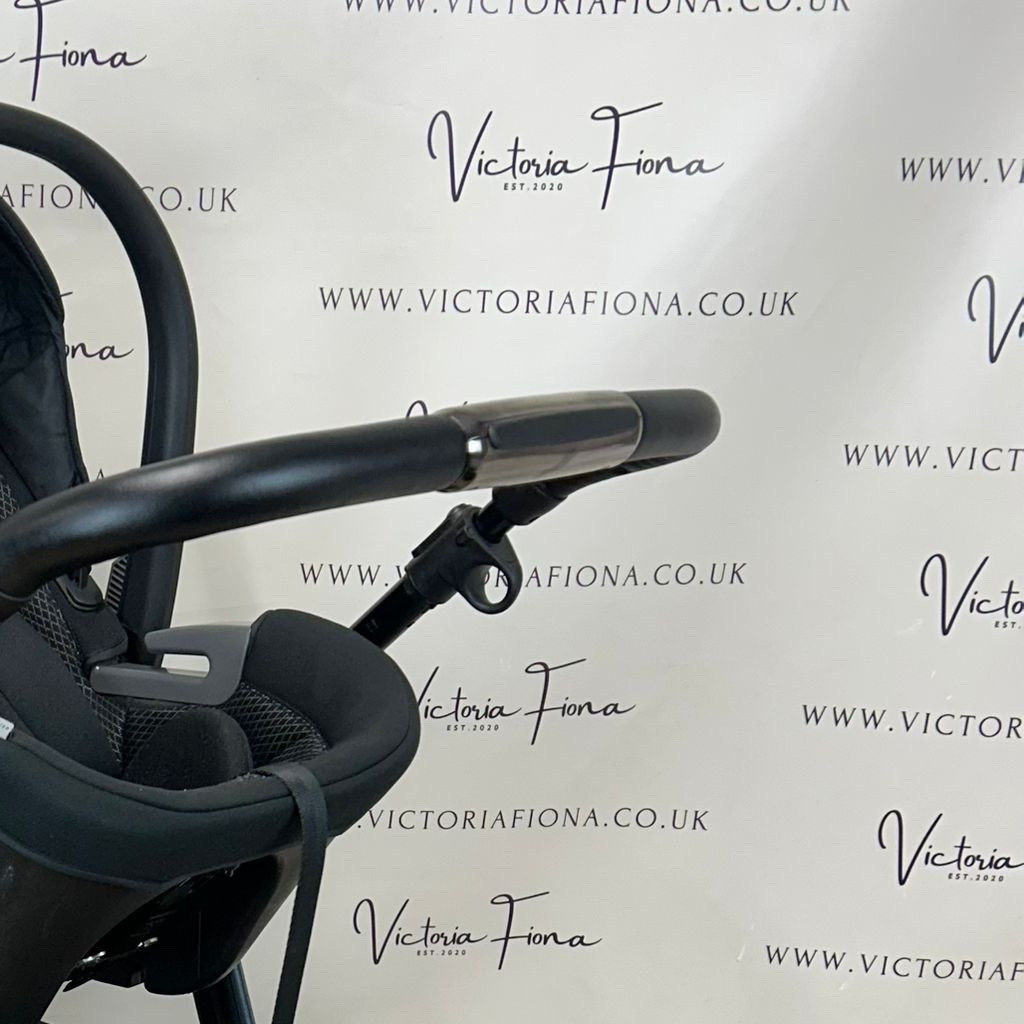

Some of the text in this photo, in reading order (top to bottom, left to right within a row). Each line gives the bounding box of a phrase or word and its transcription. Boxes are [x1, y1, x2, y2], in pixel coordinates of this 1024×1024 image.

[13, 0, 147, 102] Fiona
[427, 102, 725, 210] Victoria Fiona
[503, 182, 564, 192] EST.2020
[319, 286, 798, 318] WWW.VICTORIAFIONA.CO.UK
[445, 723, 500, 732] EST.2020
[524, 658, 637, 745] Fiona
[877, 809, 1024, 886] Victoria
[947, 872, 1005, 882] EST.2020
[352, 891, 603, 970] Victoria Fiona
[416, 949, 467, 957] EST.2020
